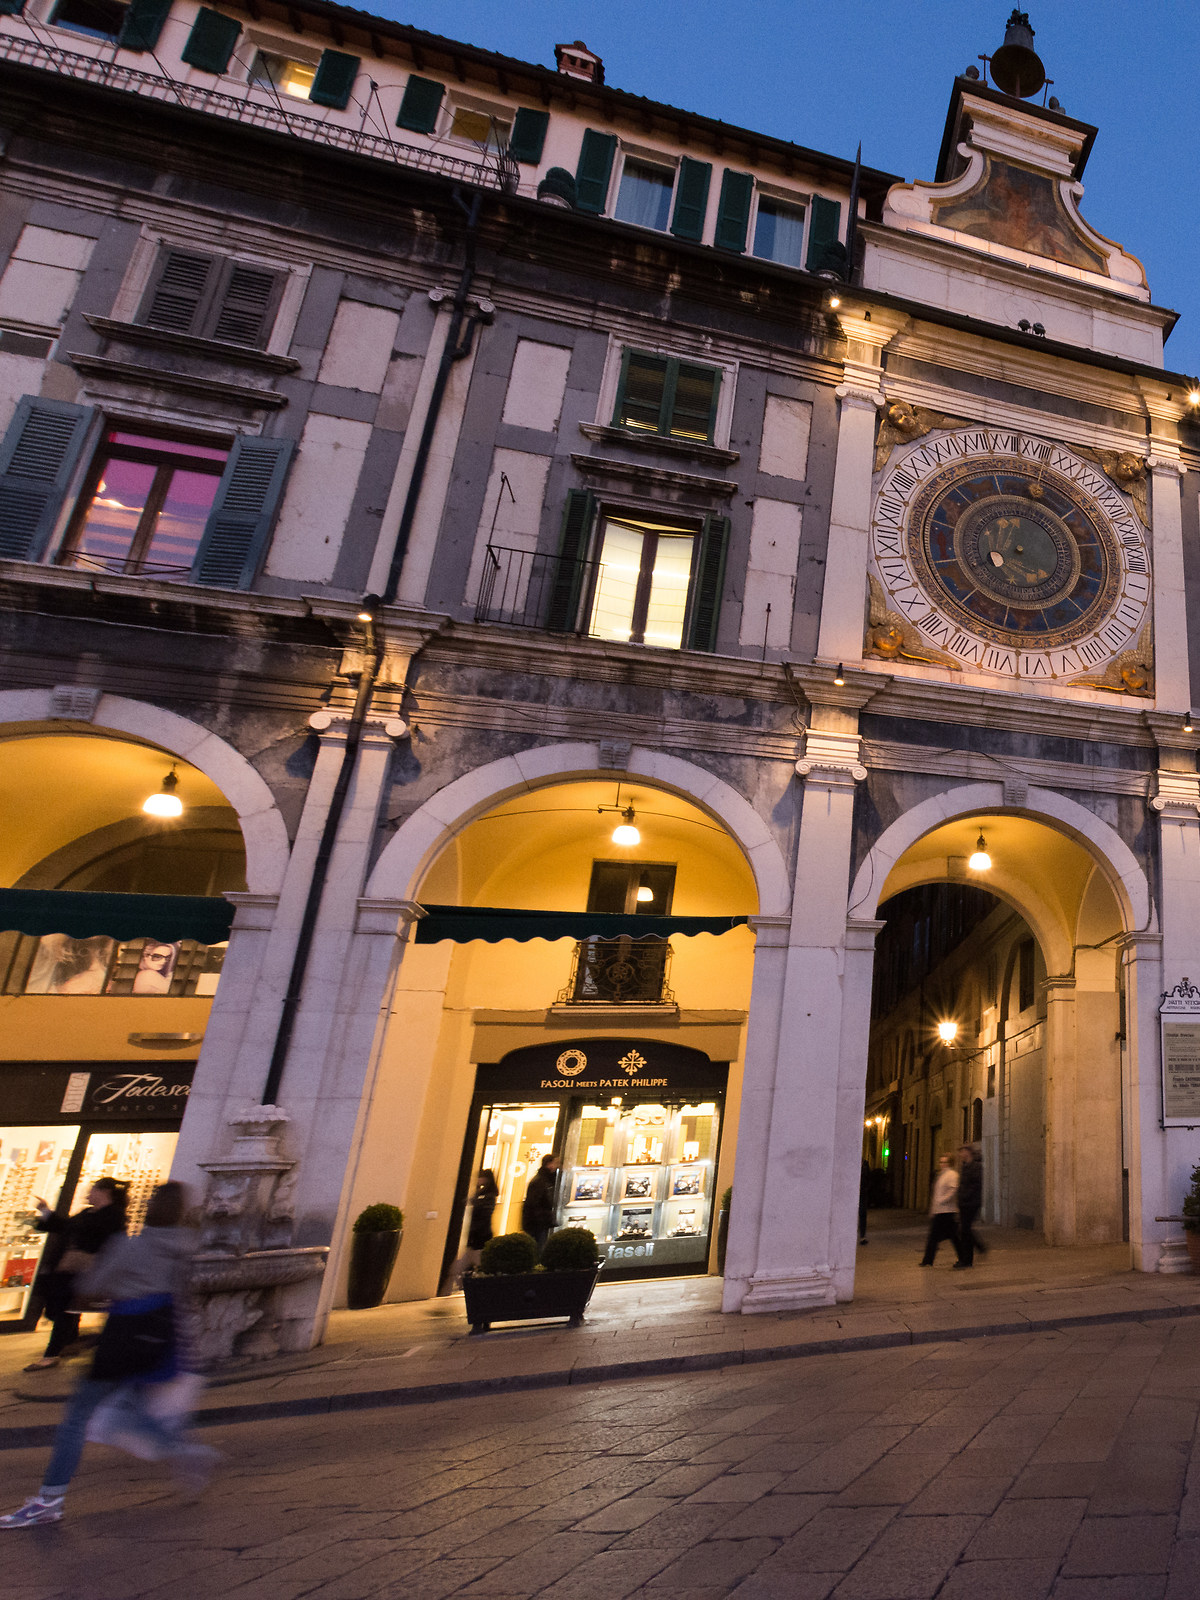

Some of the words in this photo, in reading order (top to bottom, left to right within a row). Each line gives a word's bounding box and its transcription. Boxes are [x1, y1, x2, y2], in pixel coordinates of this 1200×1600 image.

[927, 438, 959, 462] XVI
[958, 433, 989, 453] XVII
[990, 433, 1019, 452] XVIII
[904, 450, 931, 478] XV
[1052, 452, 1078, 476] XX
[886, 471, 915, 500] XIIII
[1077, 468, 1105, 494] XXI
[877, 498, 902, 525] XIII
[1099, 492, 1126, 518] XXII
[877, 529, 900, 554] XII
[1115, 519, 1140, 545] XXIII
[883, 564, 910, 585] XI
[900, 593, 926, 612] X
[1120, 603, 1140, 621] II
[919, 613, 949, 644] VIIII
[1104, 623, 1127, 646] III
[951, 635, 978, 662] VIII
[1081, 640, 1106, 664] IIII
[988, 650, 1013, 672] VII
[1025, 656, 1047, 674] VI
[1063, 654, 1077, 672] V
[93, 1073, 192, 1104] Todesc
[540, 1080, 574, 1088] FASOLI
[599, 1079, 629, 1087] PATEK
[631, 1078, 668, 1087] PHILIPPE
[607, 1242, 655, 1260] fasoli
